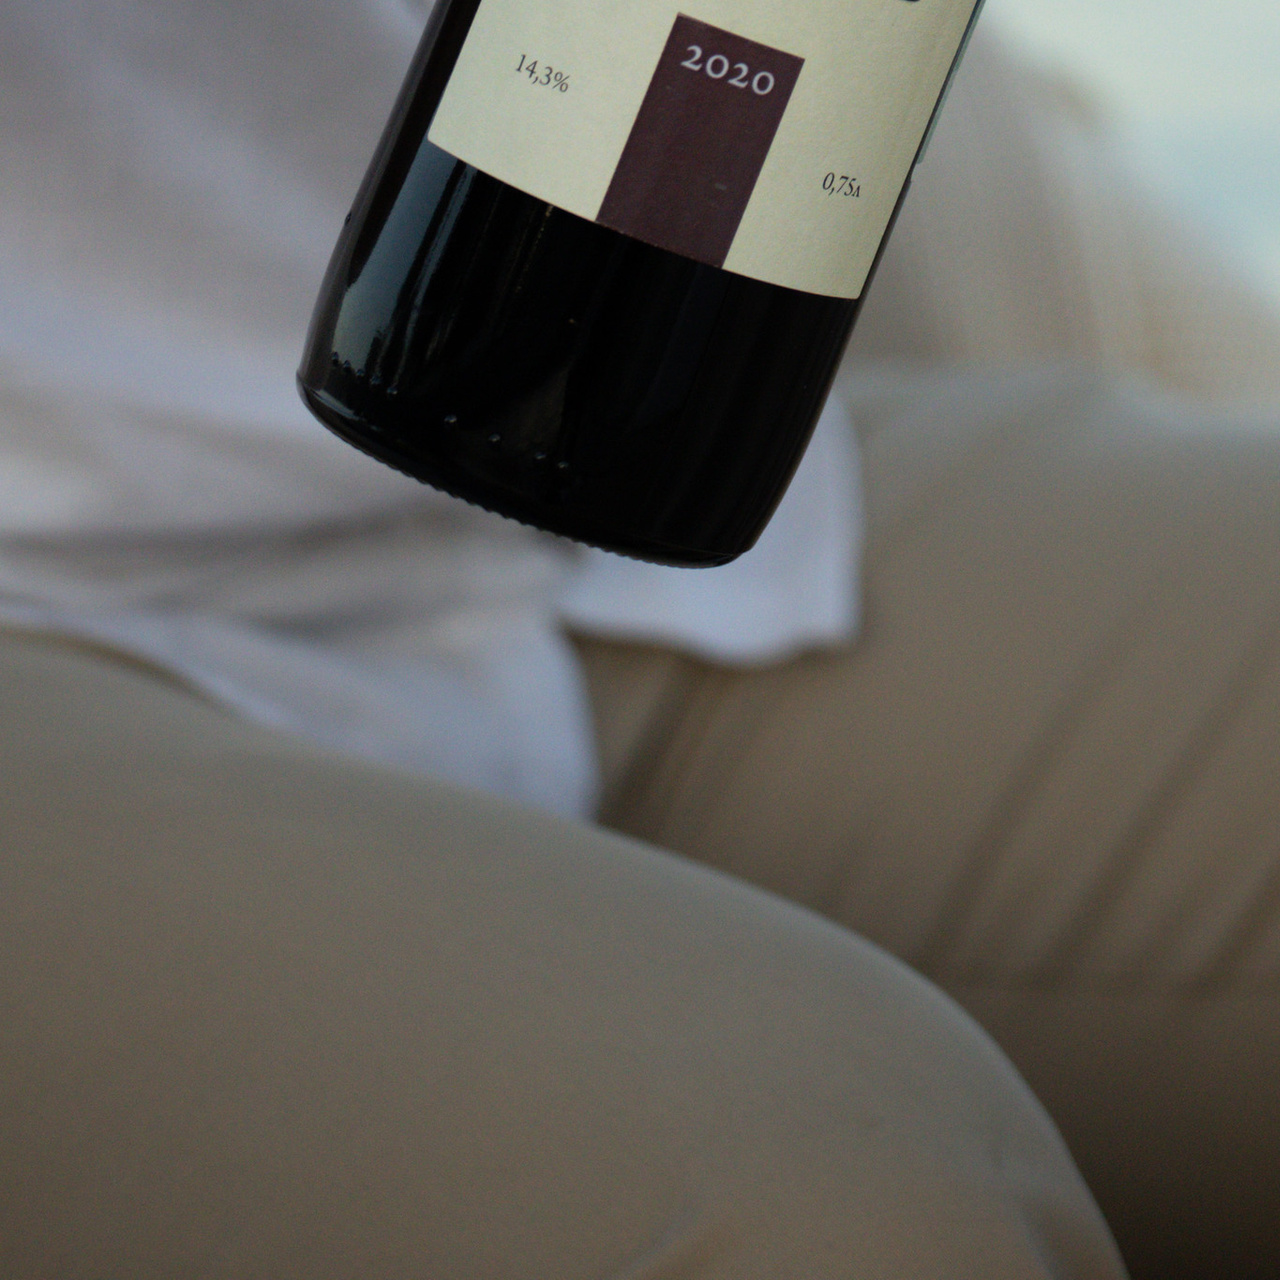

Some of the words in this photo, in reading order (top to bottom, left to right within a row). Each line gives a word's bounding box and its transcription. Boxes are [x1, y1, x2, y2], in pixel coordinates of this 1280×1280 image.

[515, 54, 570, 93] 14,3%
[680, 44, 775, 96] 2020
[822, 171, 861, 198] 0,75л
